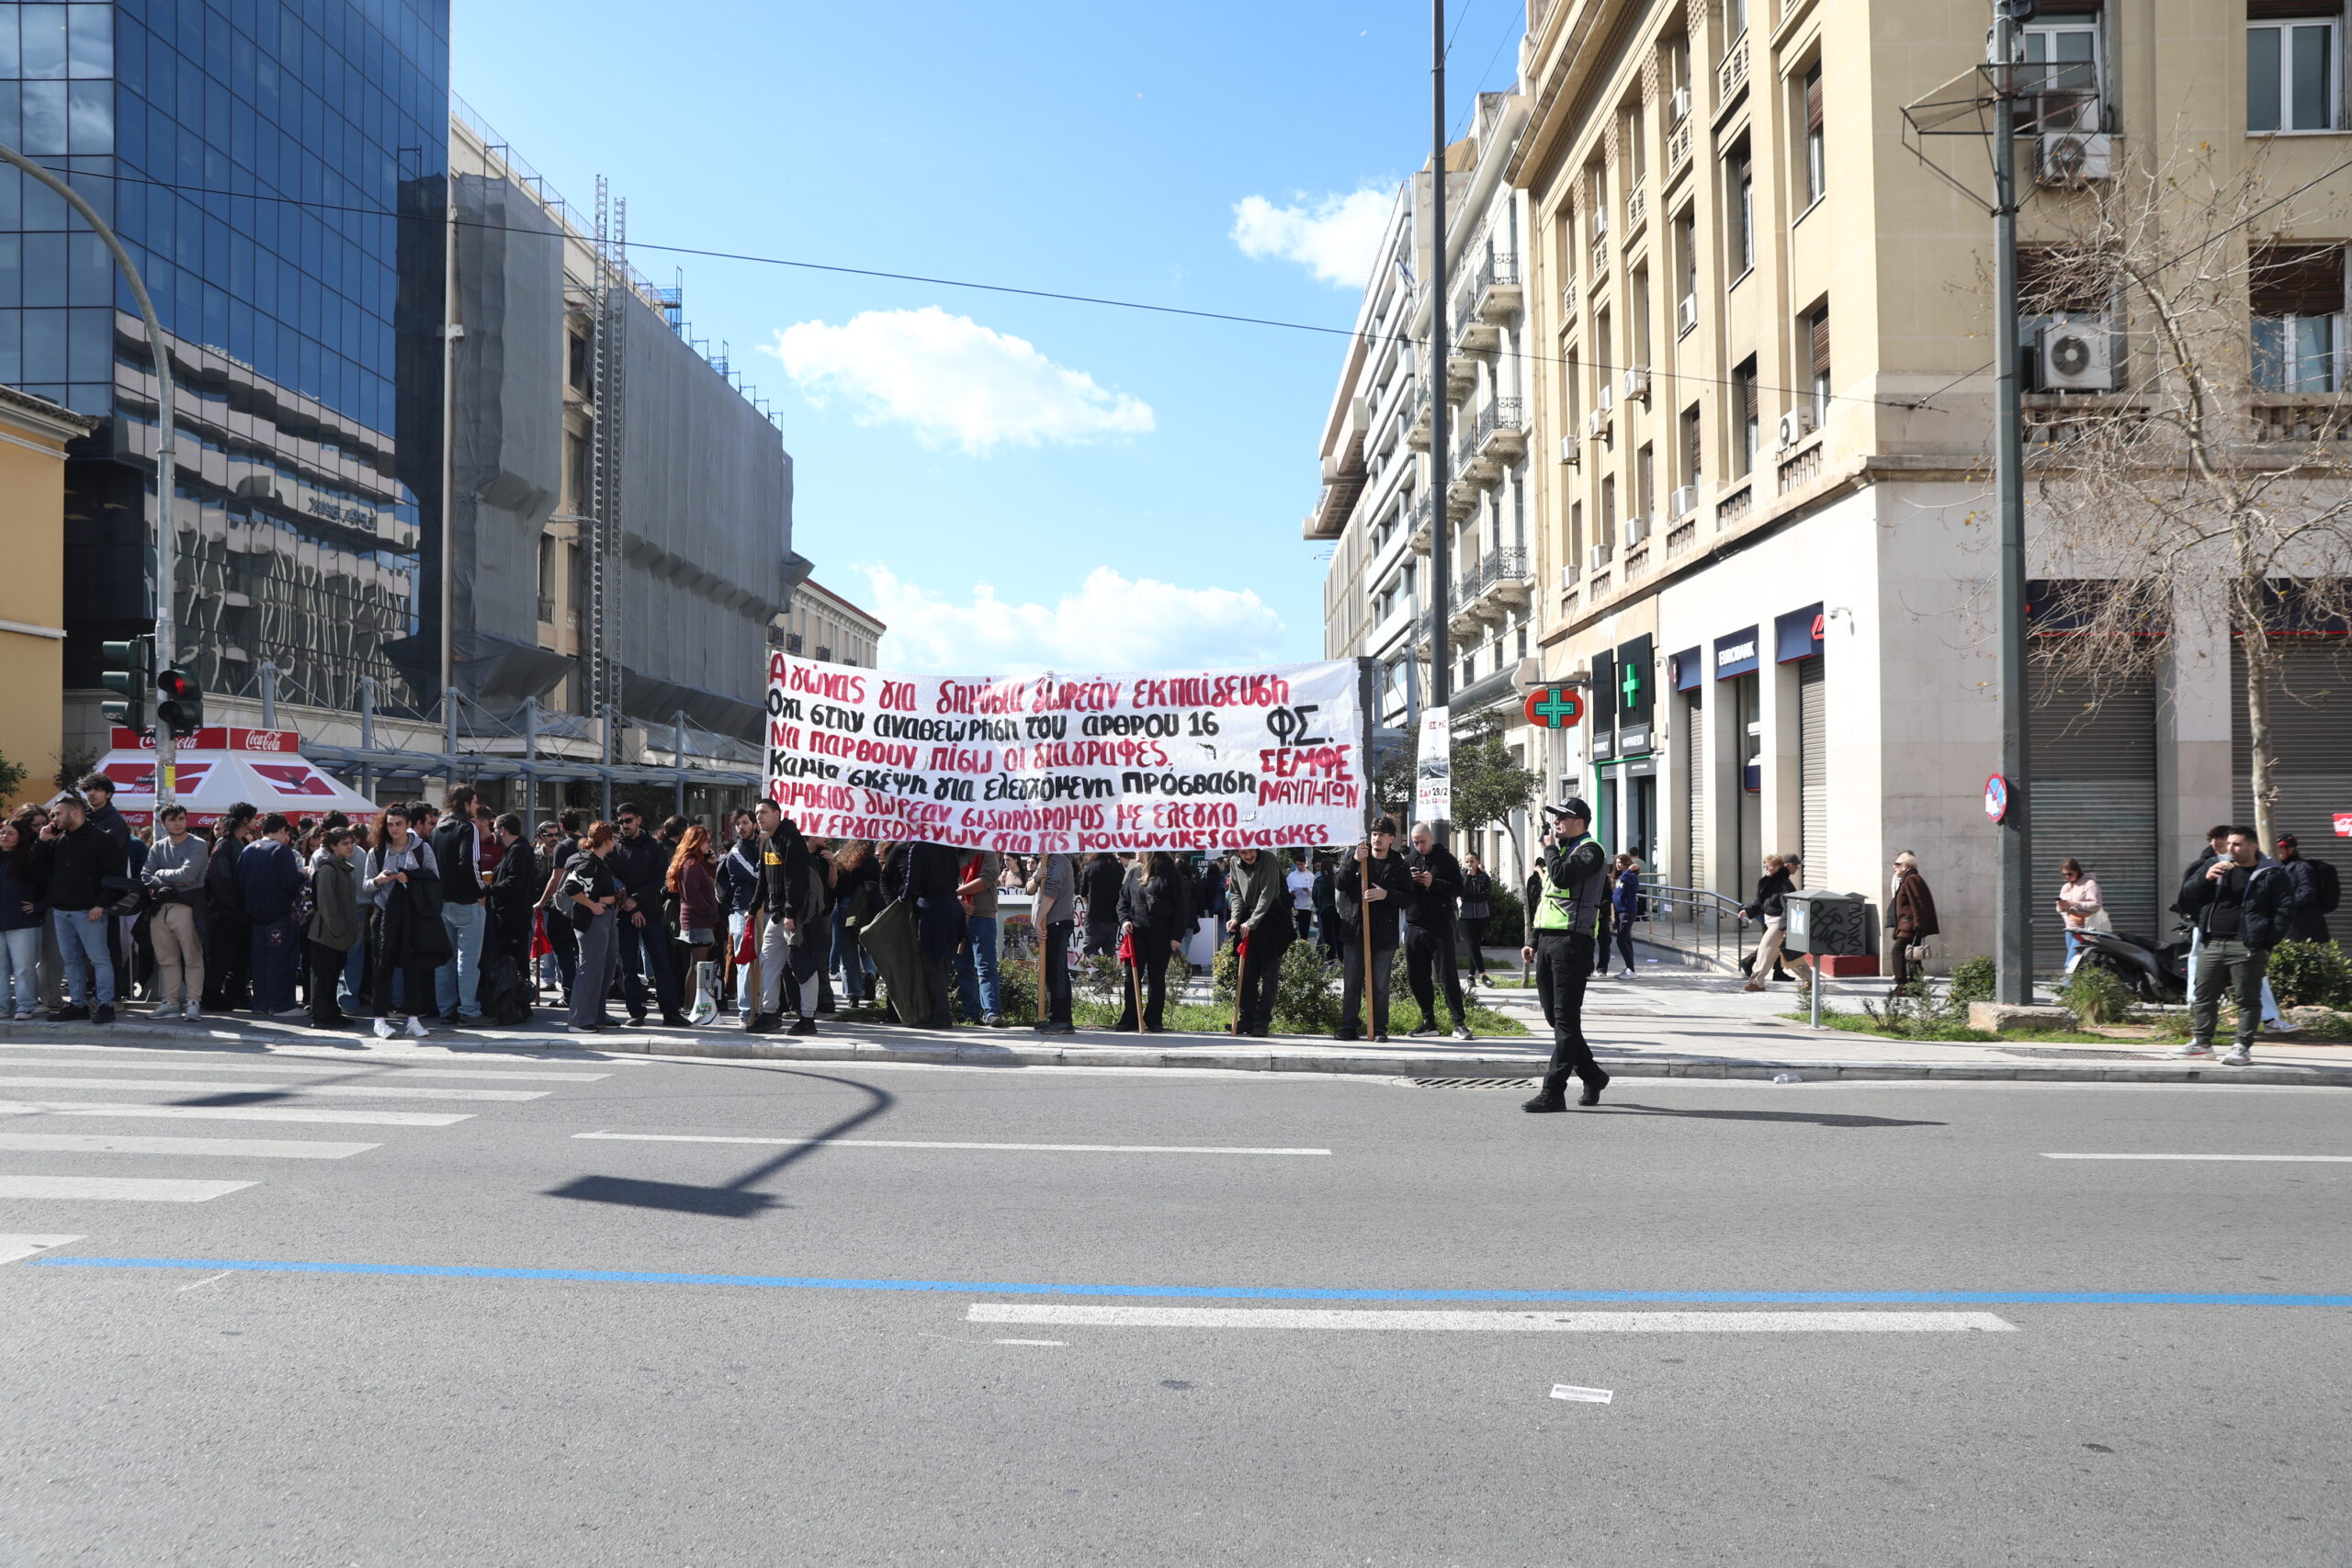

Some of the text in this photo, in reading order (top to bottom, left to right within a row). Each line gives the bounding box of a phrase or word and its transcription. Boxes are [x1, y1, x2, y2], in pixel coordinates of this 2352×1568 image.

[1718, 640, 1755, 667] EUROBANK
[879, 680, 917, 711] για
[1188, 711, 1219, 737] 16
[1266, 705, 1334, 747] Φ.Σ.
[1259, 744, 1353, 781] ΣΕΜΦΕ
[933, 776, 977, 802] για
[1258, 779, 1359, 808] ΝΑΥΠΗΓΩΝ
[1116, 803, 1145, 830] με
[991, 831, 1032, 852] για
